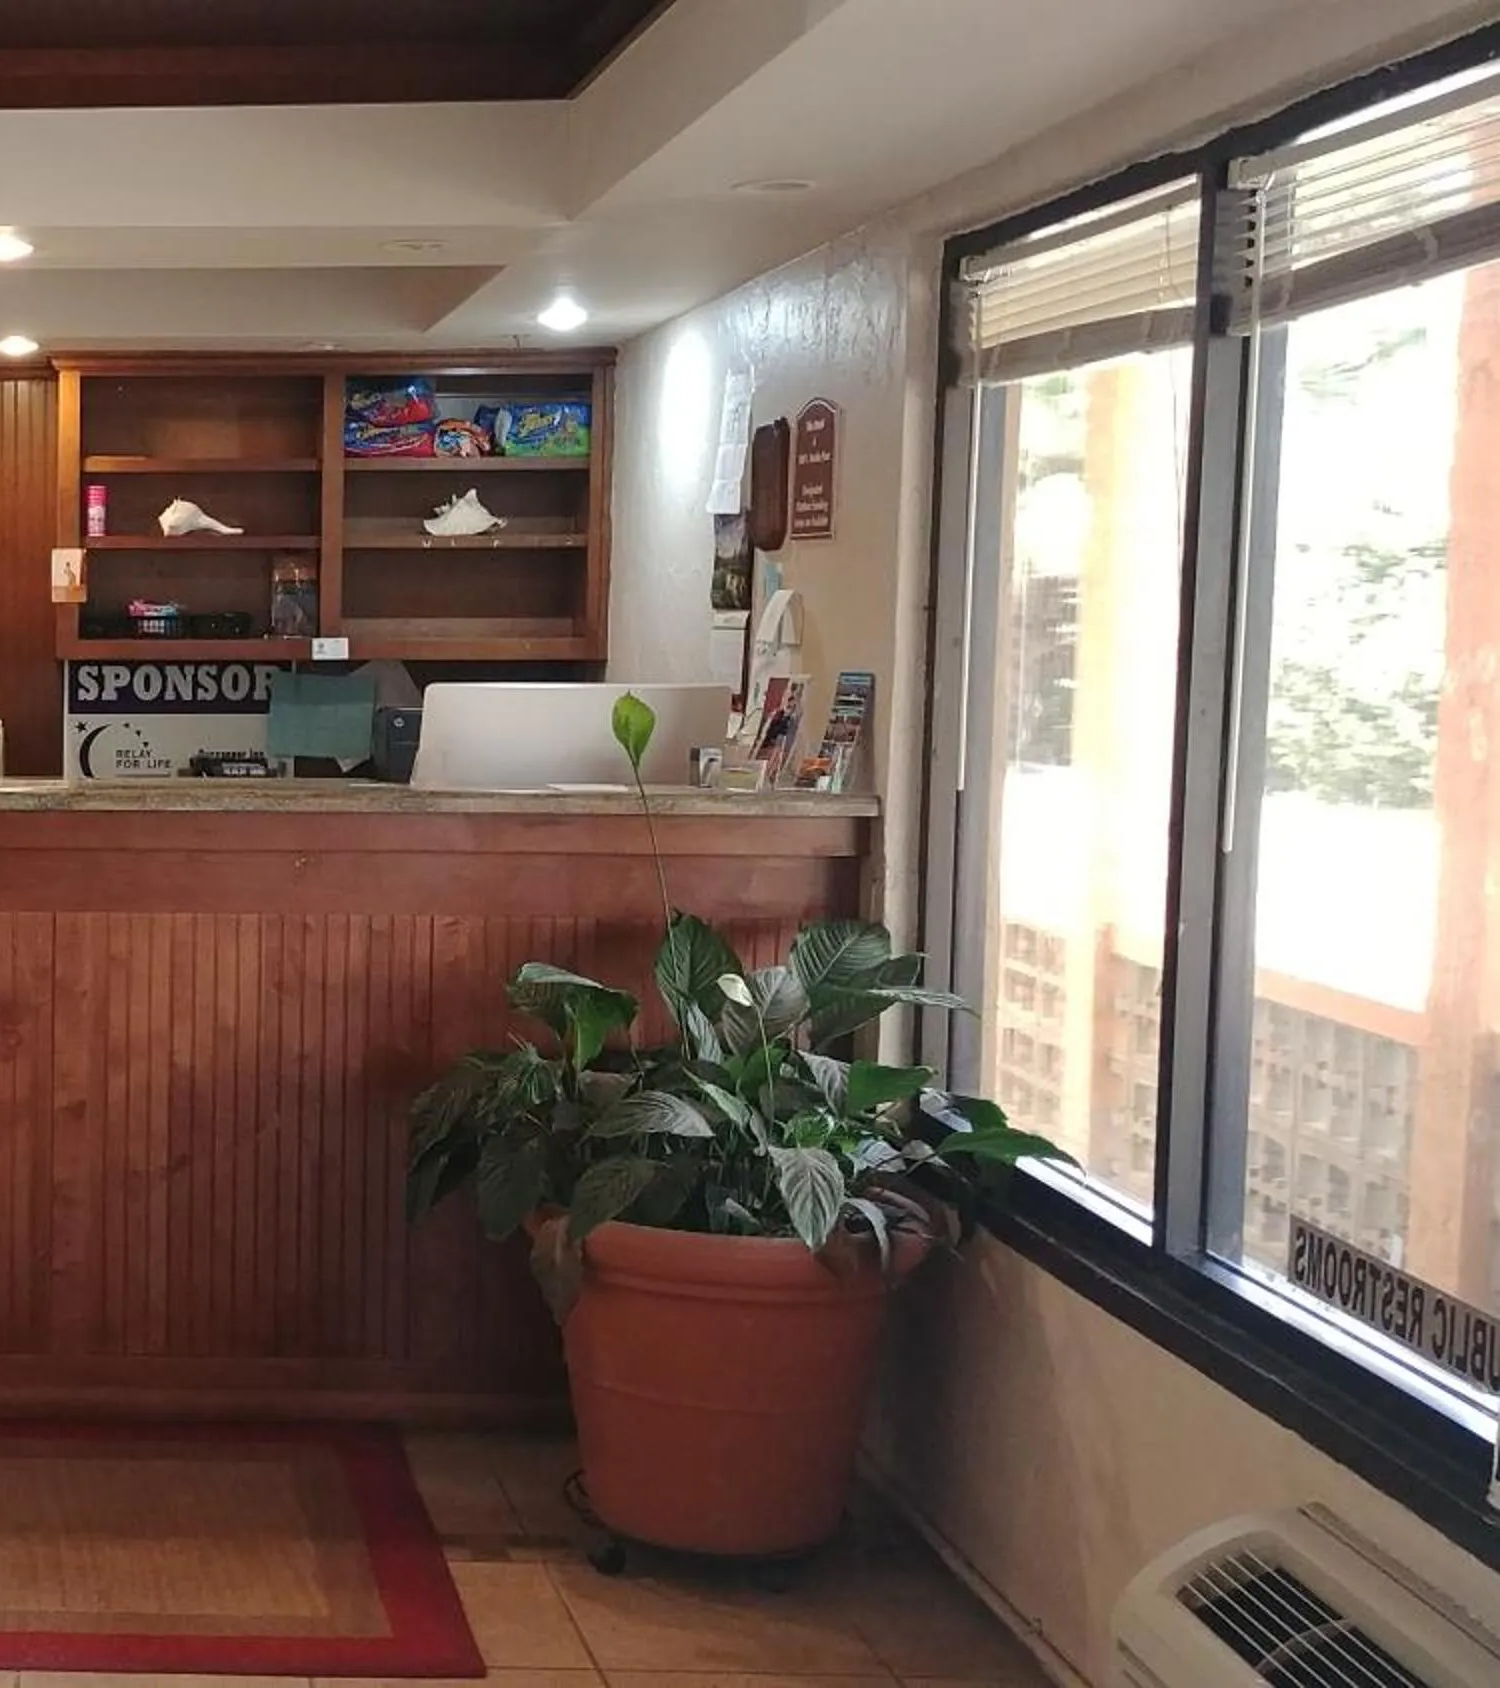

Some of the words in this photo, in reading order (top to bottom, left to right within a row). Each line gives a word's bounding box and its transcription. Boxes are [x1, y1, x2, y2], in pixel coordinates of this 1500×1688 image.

[115, 749, 153, 759] RELAY
[115, 759, 140, 769] FOR
[147, 759, 172, 769] LIFE
